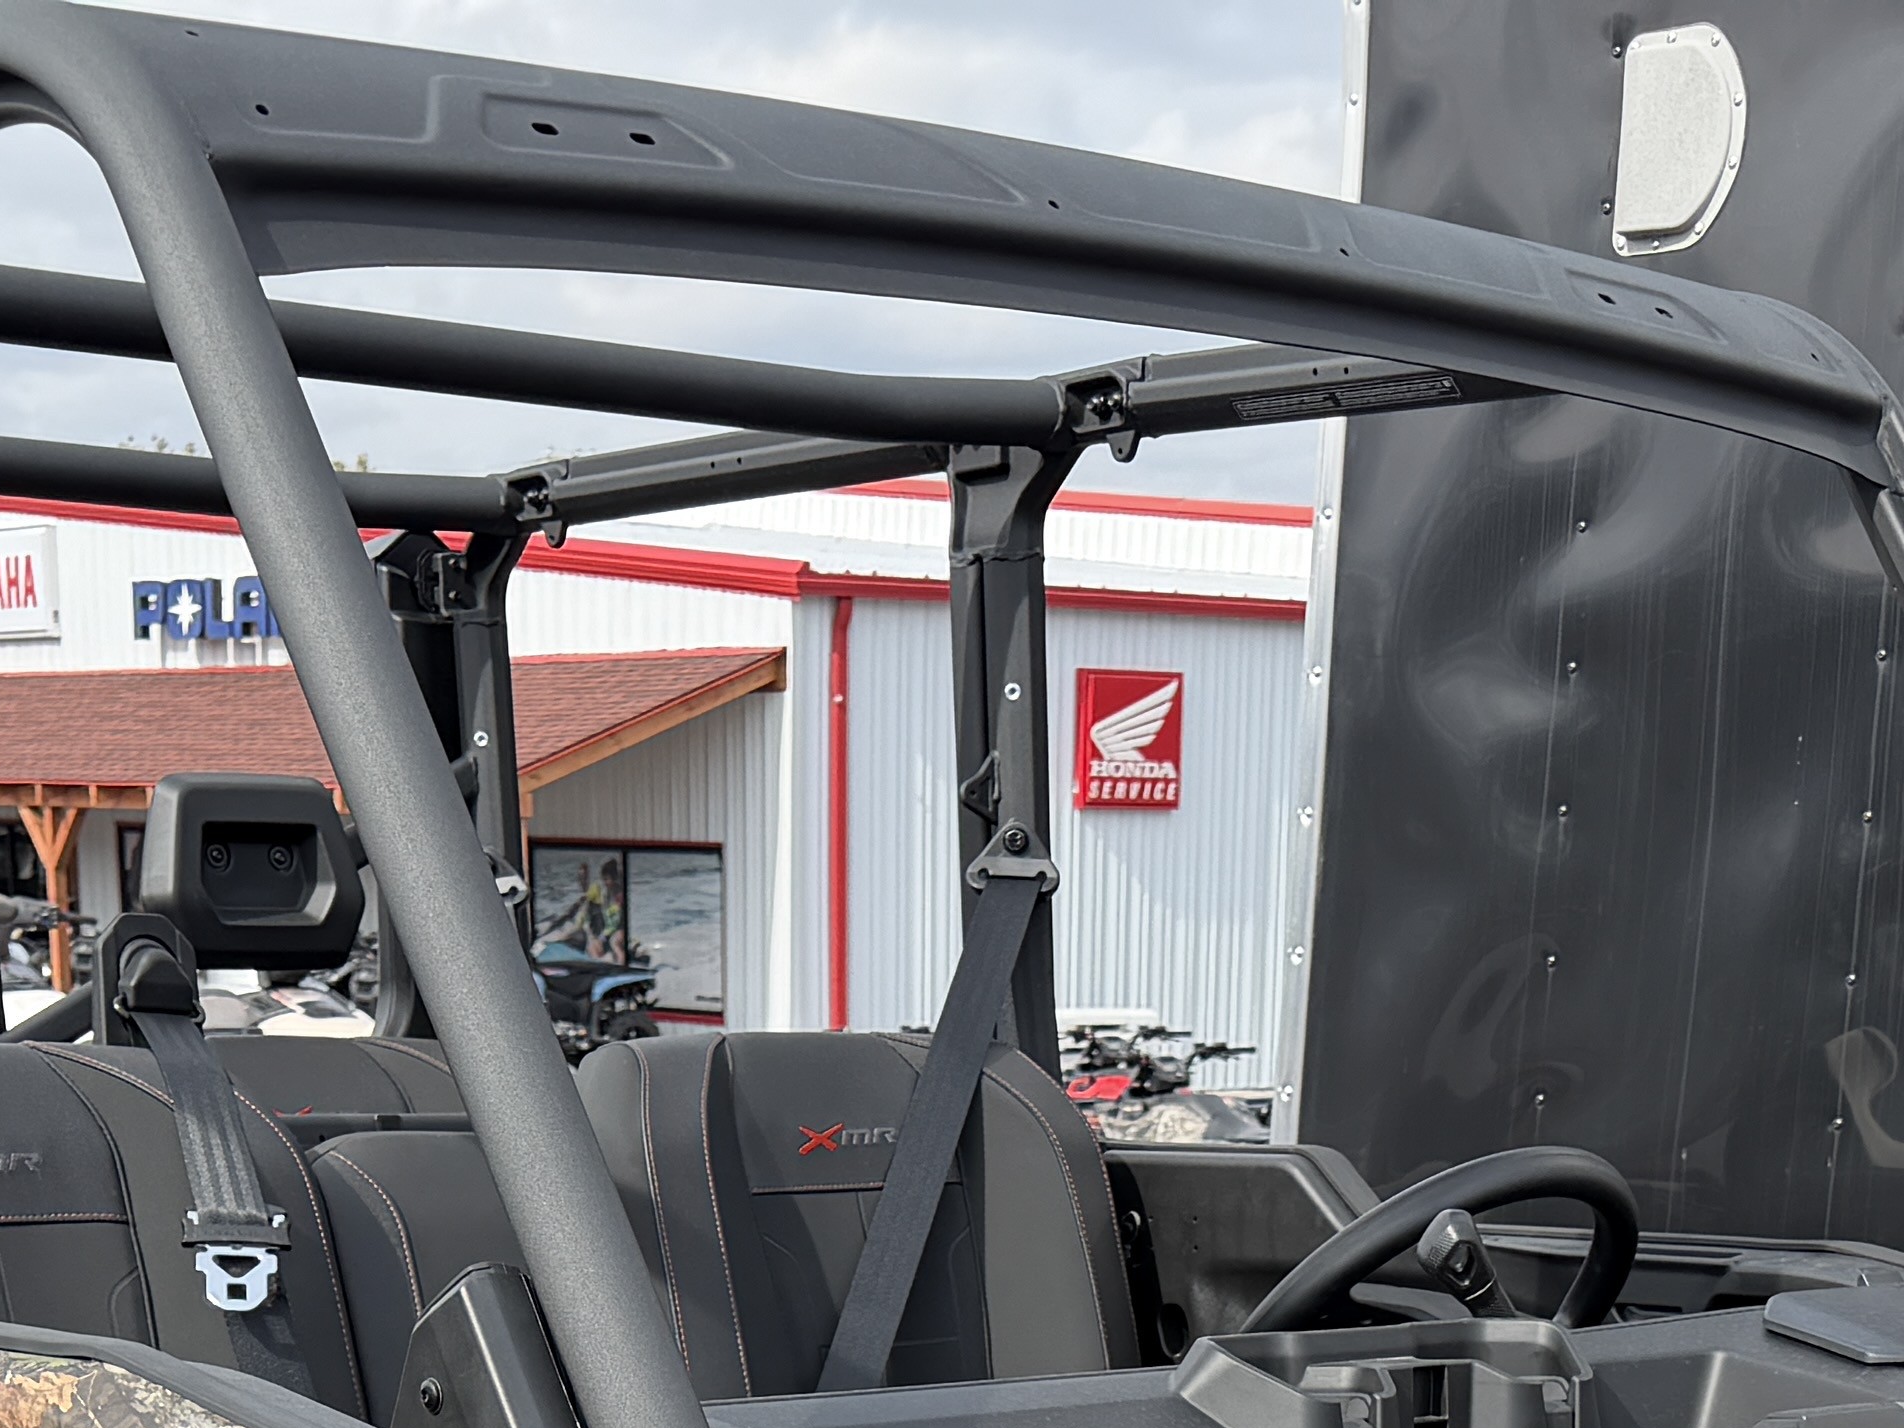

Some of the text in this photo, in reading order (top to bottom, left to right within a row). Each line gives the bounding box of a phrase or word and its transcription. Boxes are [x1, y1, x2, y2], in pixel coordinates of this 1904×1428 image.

[132, 576, 281, 641] POLA
[1089, 760, 1177, 779] HONDA
[1089, 780, 1177, 800] SERVICE
